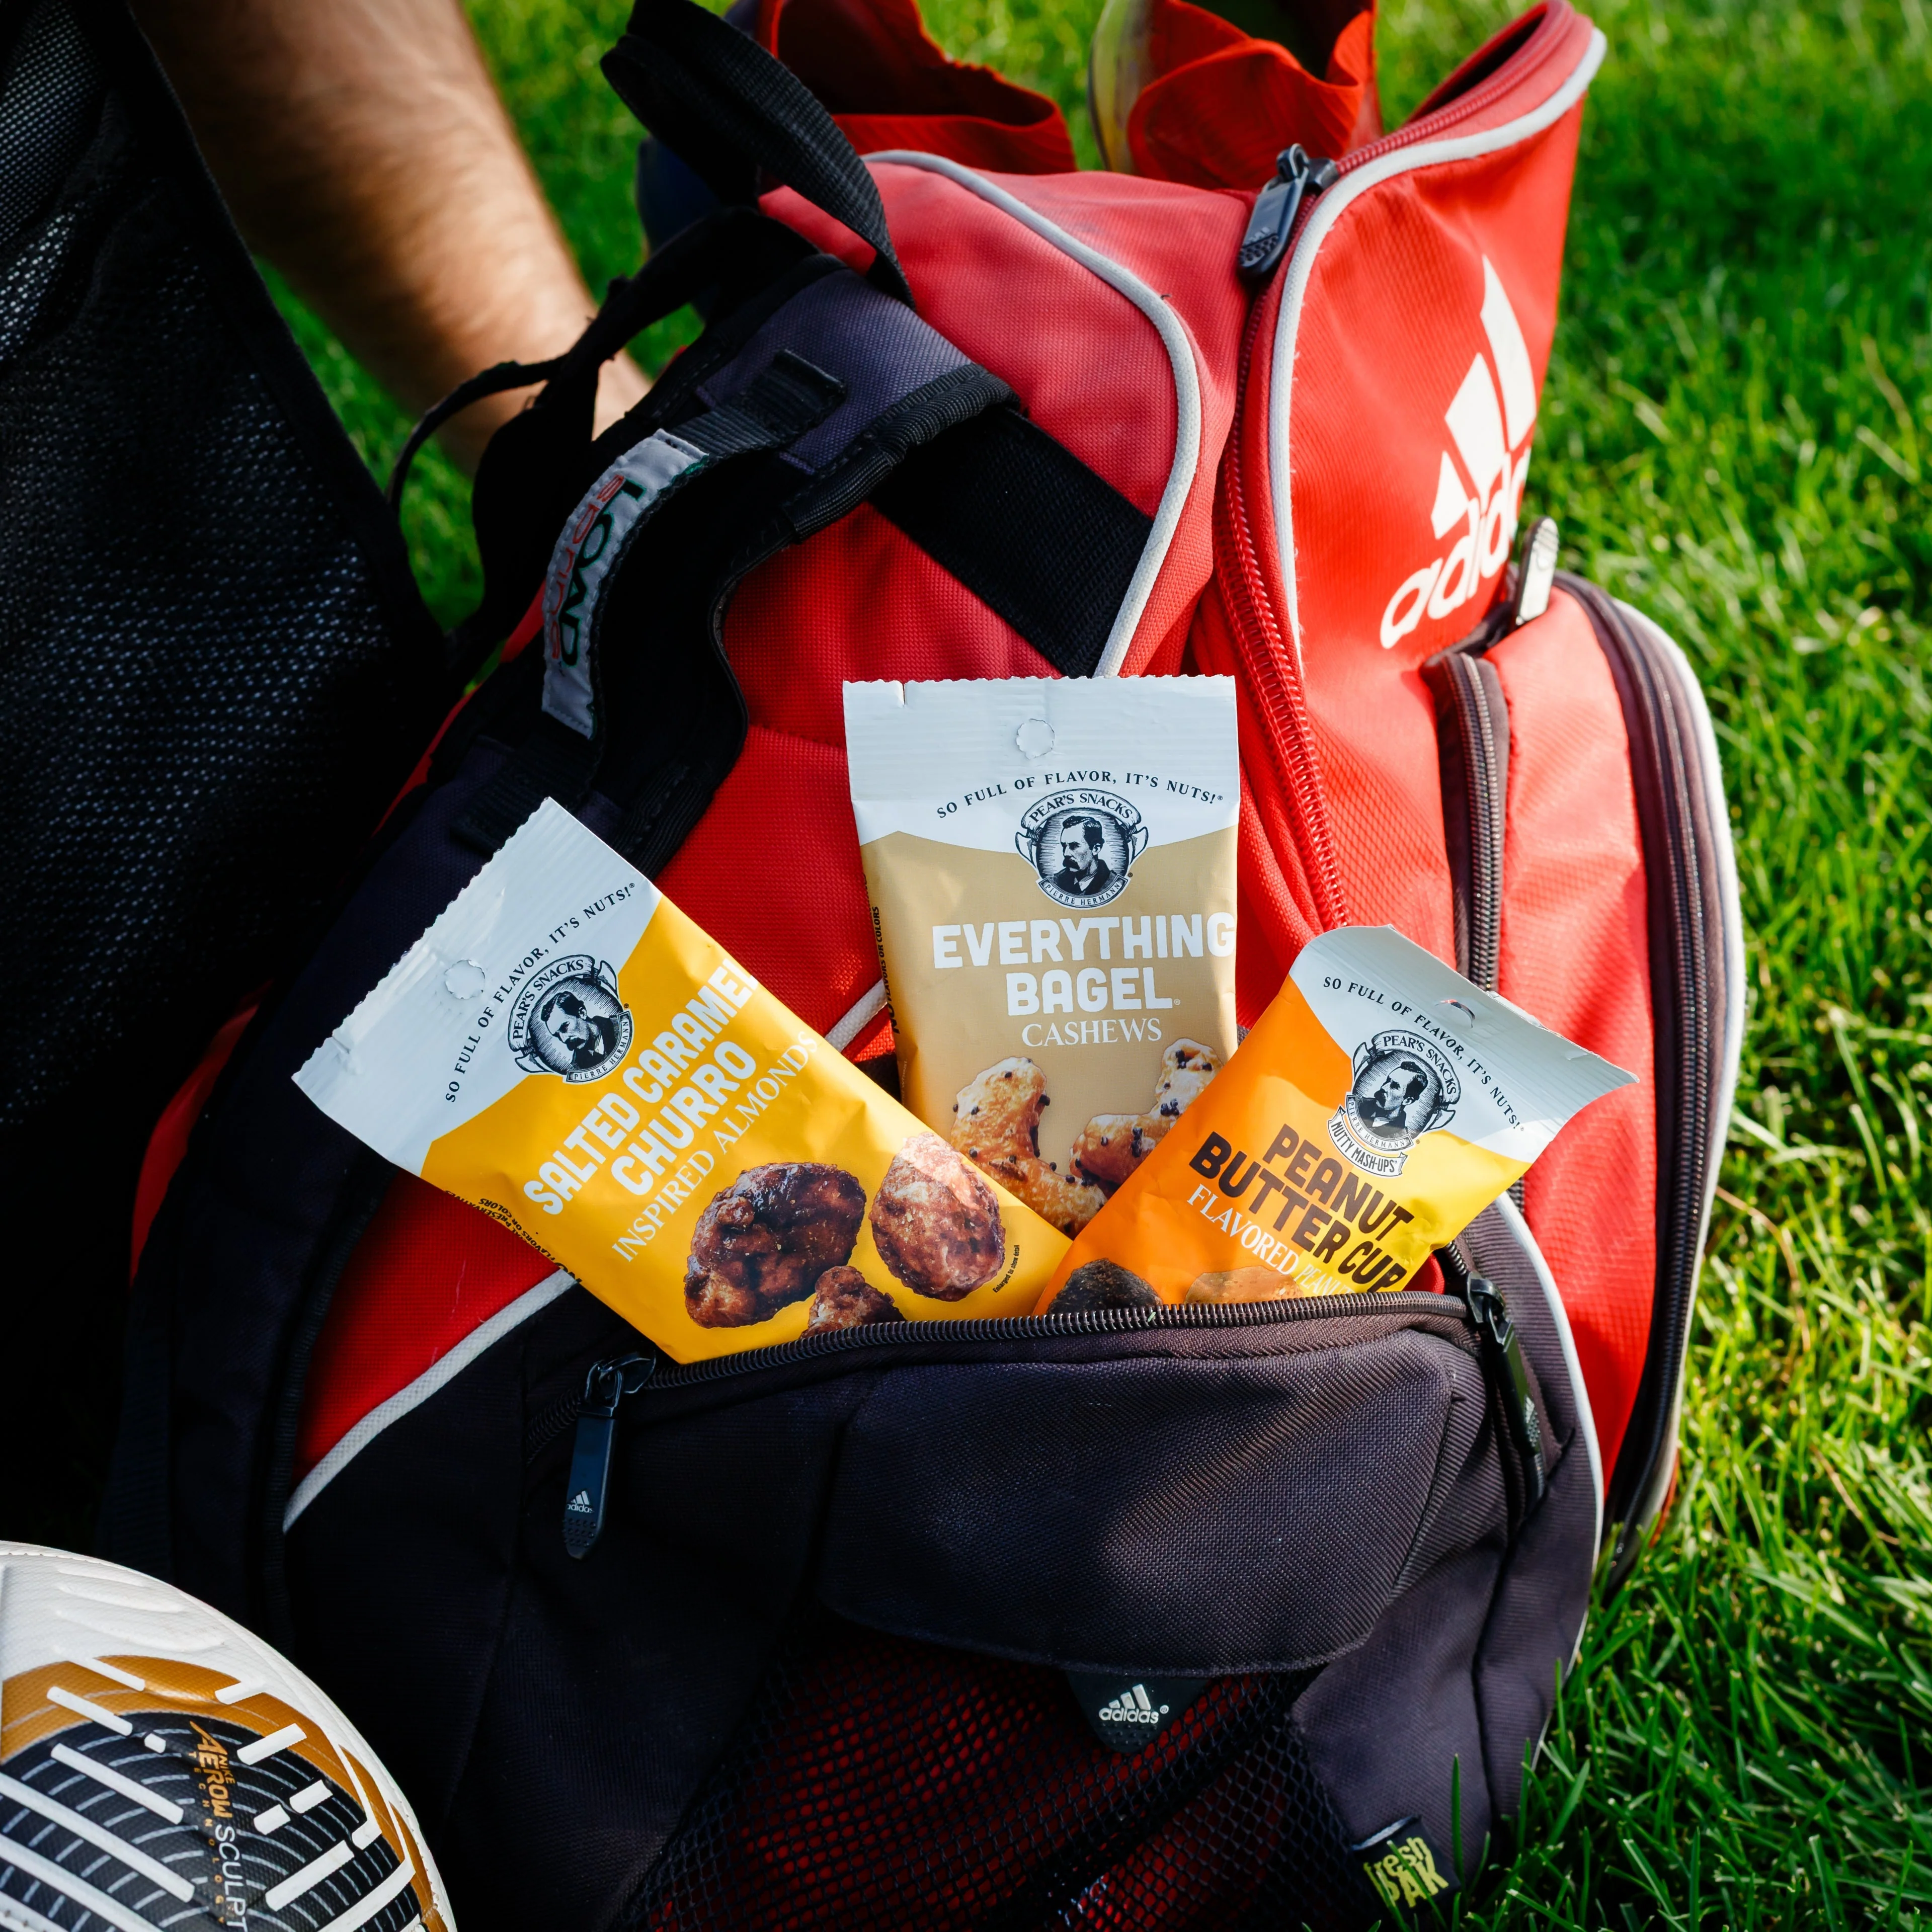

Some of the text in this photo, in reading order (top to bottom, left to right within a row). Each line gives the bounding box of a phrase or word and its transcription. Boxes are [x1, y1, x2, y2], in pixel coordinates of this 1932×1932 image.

[559, 479, 646, 667] LOAD
[1380, 447, 1531, 649] adid
[937, 802, 957, 818] SO
[964, 784, 1007, 806] FULL
[1014, 777, 1035, 789] OF
[1044, 771, 1116, 784] FLAVOR,
[1125, 773, 1158, 787] IT'S
[1029, 793, 1133, 823] PEAR'S SNACKS
[1045, 883, 1121, 905] PIERRE HERMANN
[872, 906, 882, 943] COLORS
[878, 945, 884, 957] OR
[932, 912, 1235, 969] EVERYTHING
[445, 1081, 460, 1102] SO
[454, 1033, 480, 1074] FULL
[477, 1006, 494, 1028] OF
[493, 948, 549, 1003] FLAVOR,
[548, 917, 580, 944] IT'S
[513, 959, 584, 1040] PEAR'S SNACKS
[573, 1020, 629, 1080] PIERRE HERMANN
[1022, 1019, 1162, 1048] CASHEWS
[1323, 977, 1341, 989] SO
[1348, 982, 1384, 1004] FULL
[1392, 1001, 1412, 1015] OF
[1414, 1014, 1464, 1060] FLAVOR,
[1467, 1059, 1491, 1085] IT'S
[523, 958, 758, 1215] SALTED CARAMEL
[1383, 1035, 1457, 1095] PEAR'S SNACKS
[611, 1040, 756, 1196] CHURRO
[611, 1031, 818, 1263] INSPIRED ALMONDS
[1331, 1121, 1354, 1153] NUTTY
[1349, 1102, 1405, 1148] PIERRE HERMANN
[478, 1198, 512, 1218] COLORS
[1188, 1131, 1407, 1293] BUTTER CUP
[1262, 1123, 1415, 1241] PEANUT
[511, 1218, 522, 1231] OR
[1187, 1184, 1299, 1275] FLAVORED
[992, 1274, 1011, 1293] Enlarged
[1010, 1257, 1018, 1268] show
[218, 1754, 235, 1785] NIKE
[190, 1721, 248, 1932] AEROW SCULPT
